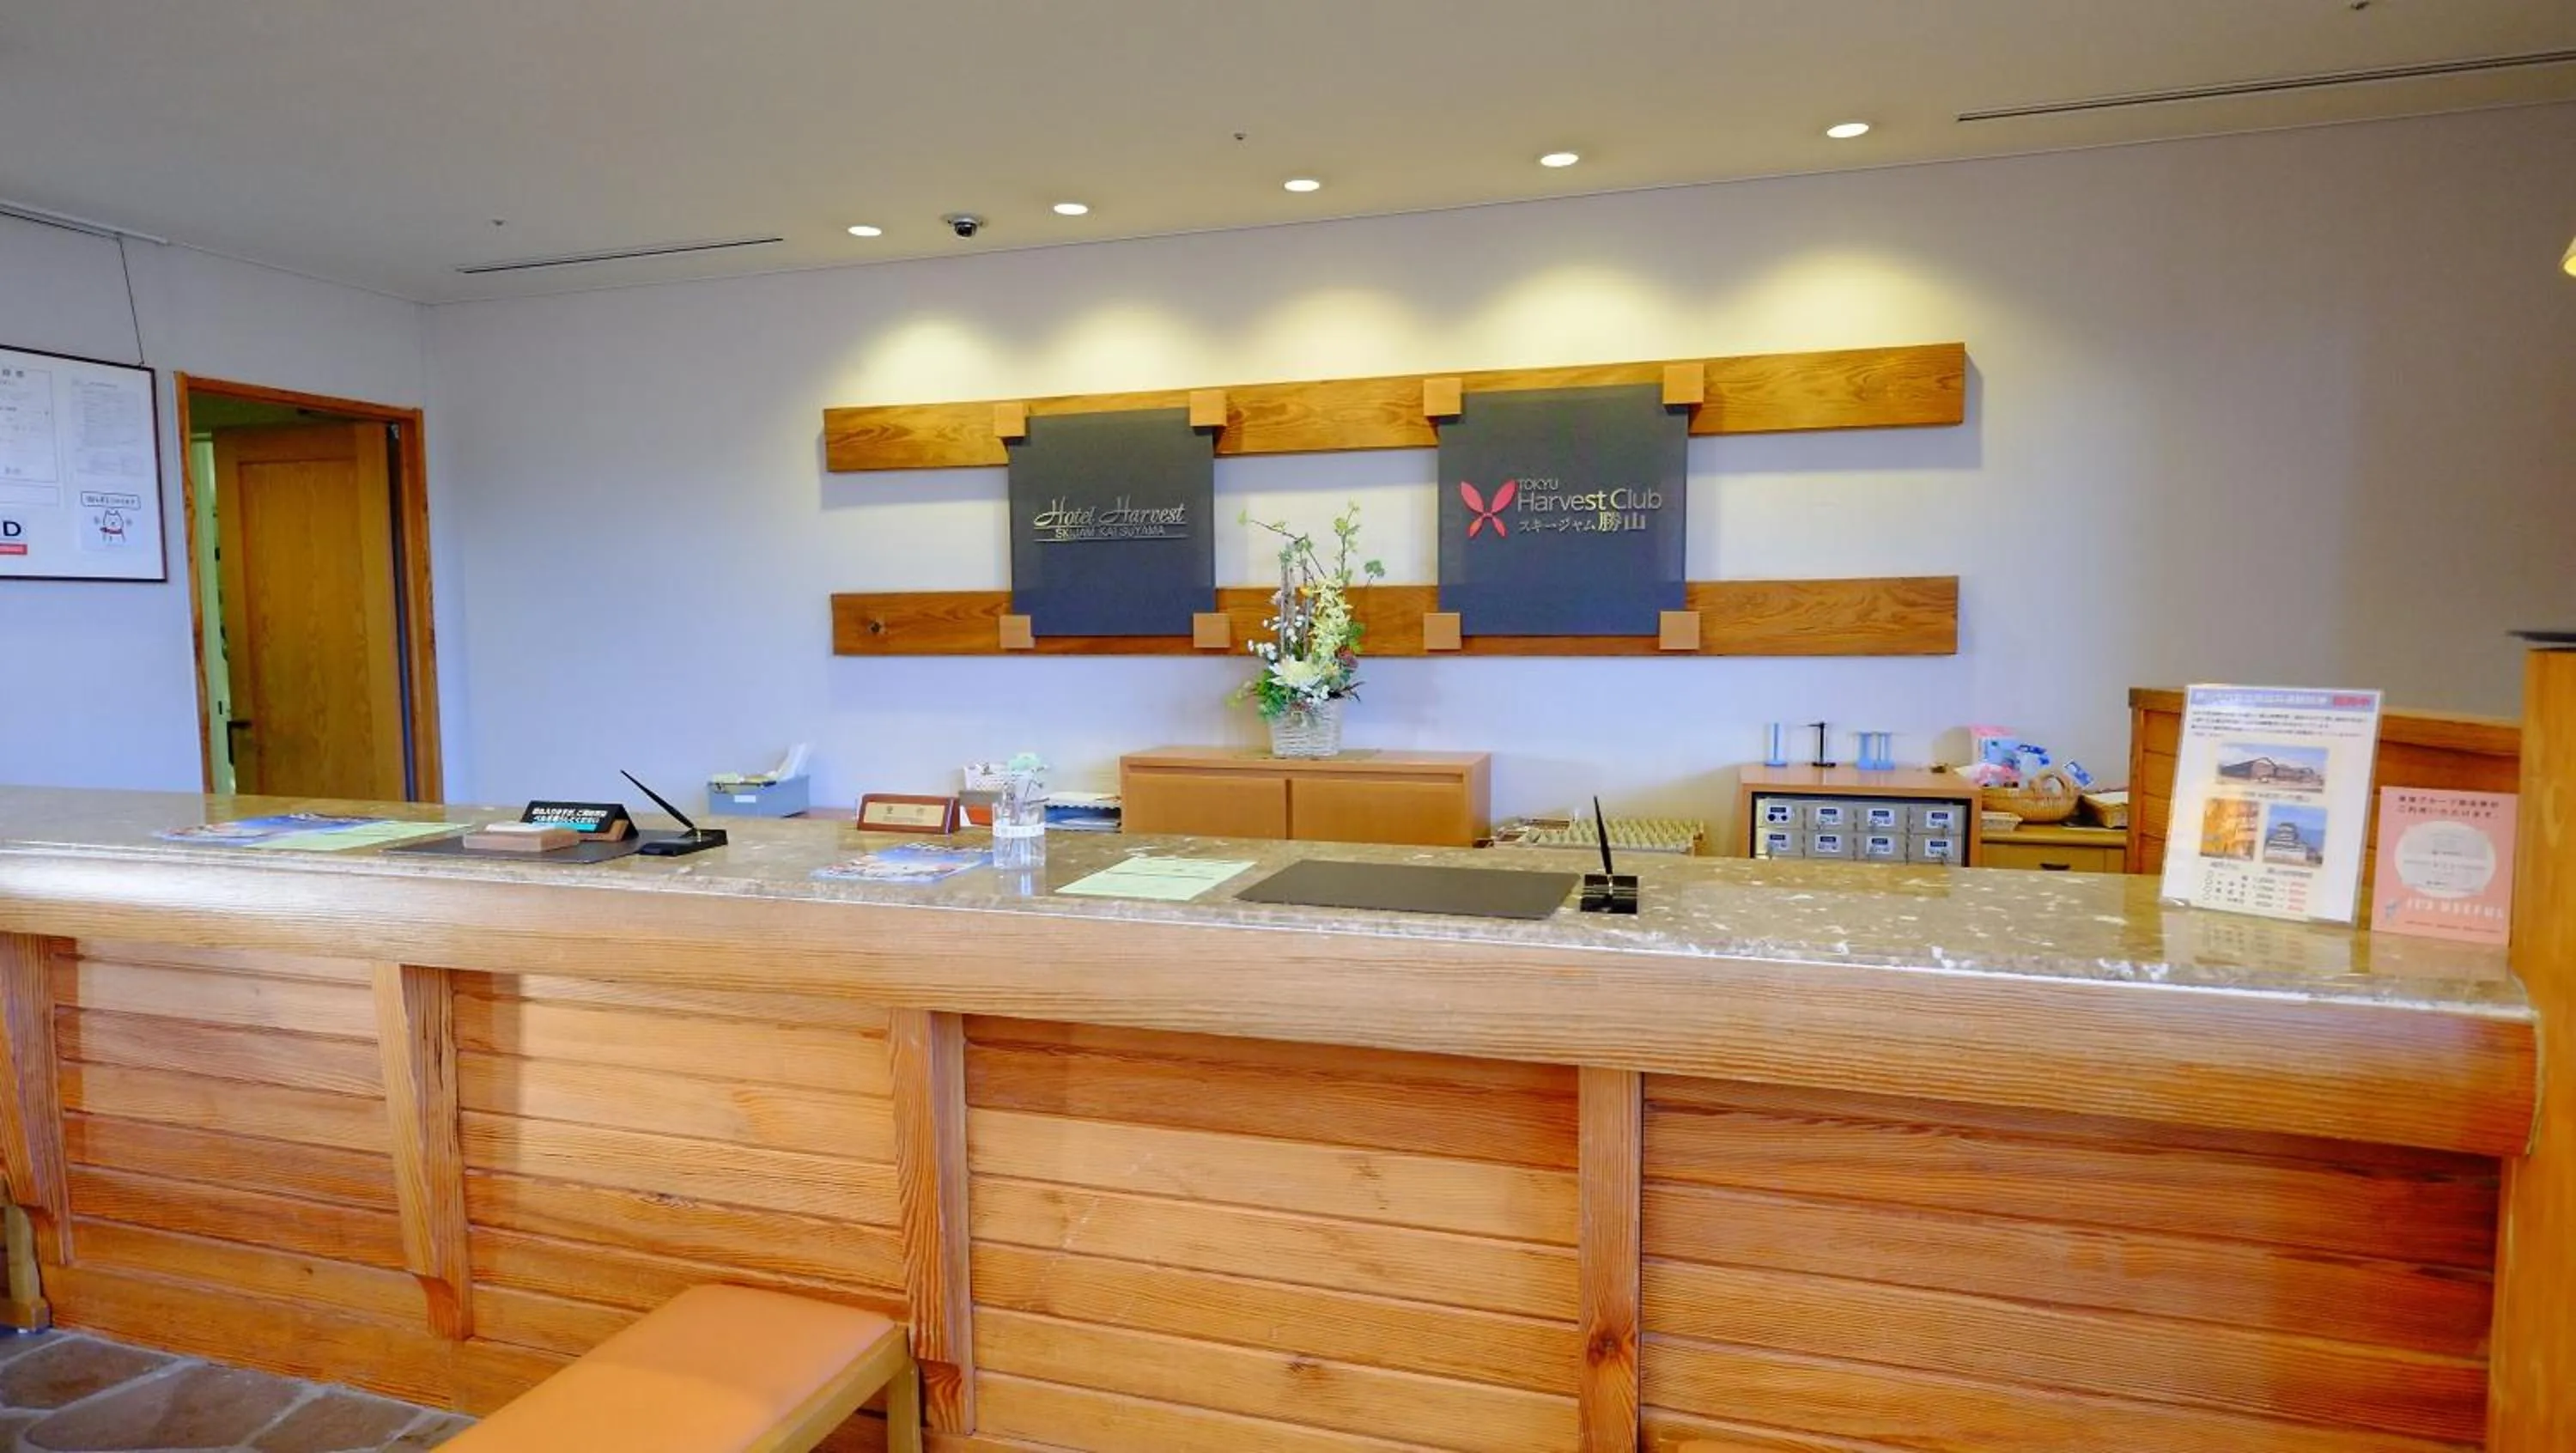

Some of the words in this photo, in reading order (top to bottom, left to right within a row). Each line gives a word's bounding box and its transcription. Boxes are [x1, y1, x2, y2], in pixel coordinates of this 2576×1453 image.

[1518, 478, 1559, 489] TOKYU
[1033, 495, 1095, 526] Hotel
[1098, 494, 1186, 524] Harvest
[1517, 490, 1607, 512] Harvest
[1610, 488, 1662, 510] Club
[1518, 511, 1647, 532] スキージャム勝山
